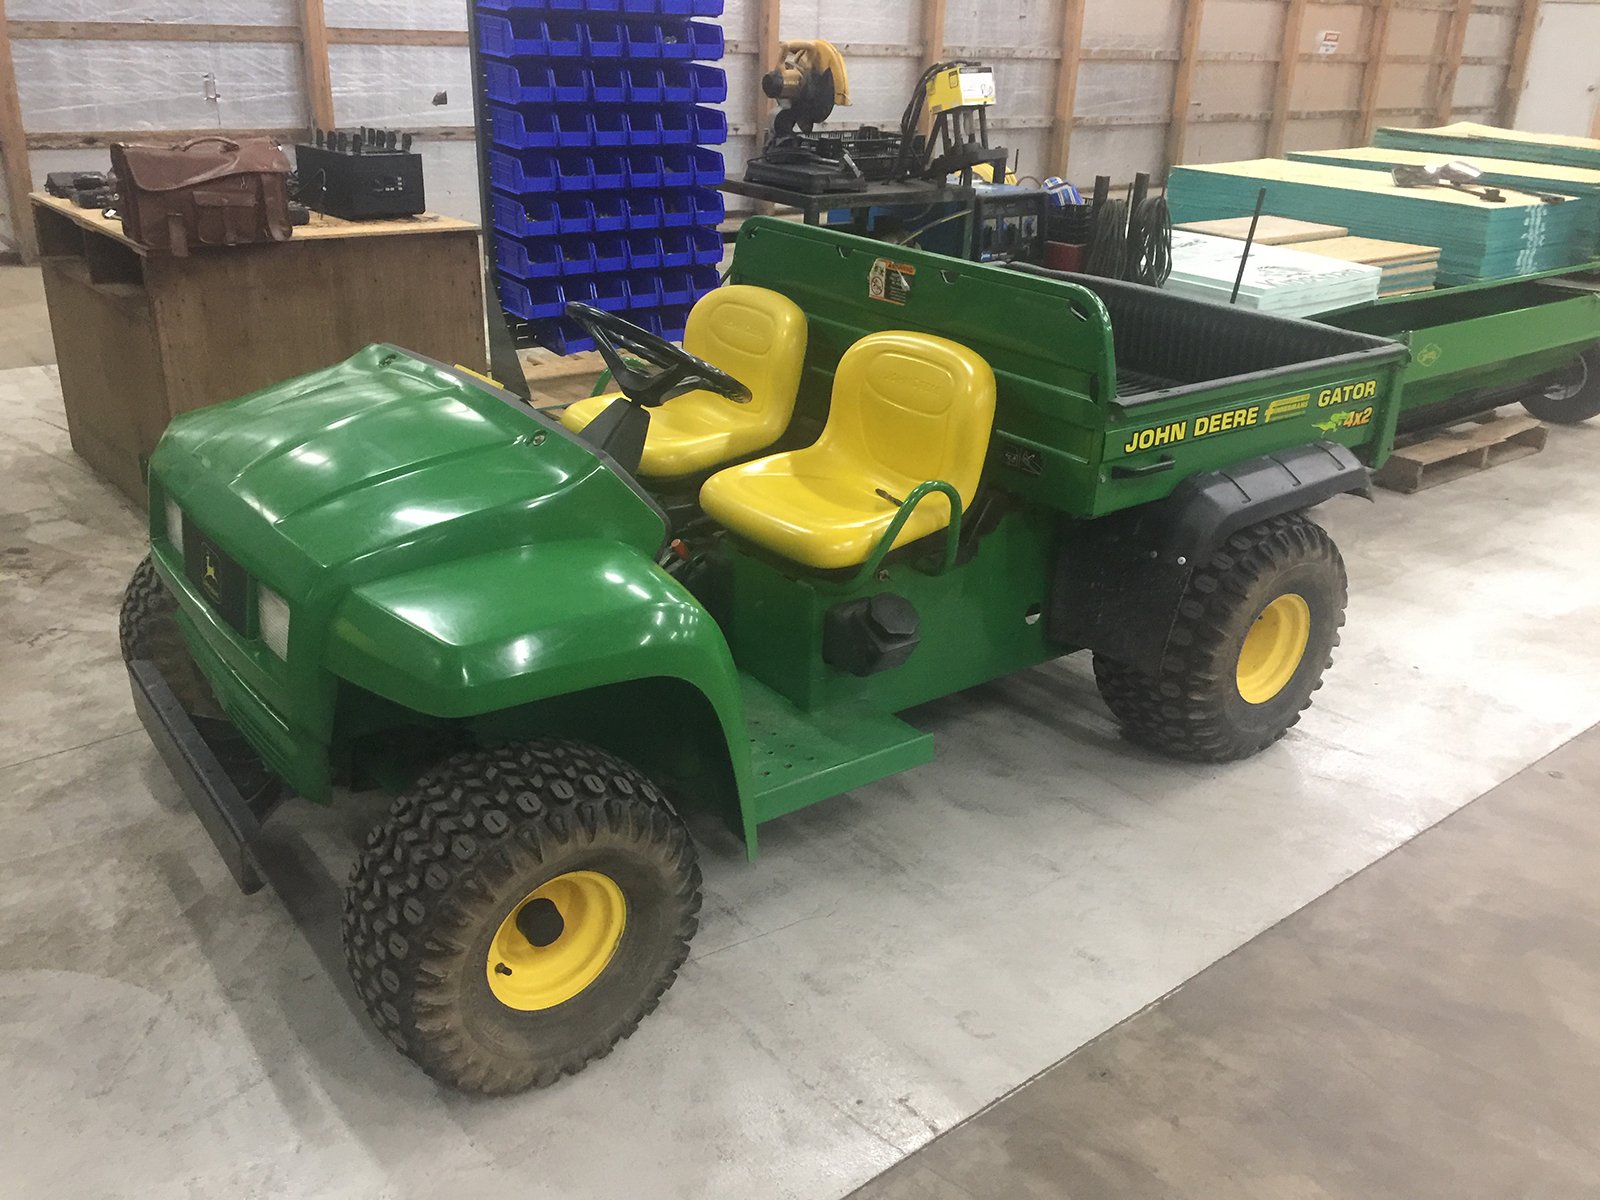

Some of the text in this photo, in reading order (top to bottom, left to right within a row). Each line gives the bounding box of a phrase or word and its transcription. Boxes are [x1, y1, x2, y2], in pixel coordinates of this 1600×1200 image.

[1317, 379, 1377, 408] GATOR
[1124, 420, 1187, 453] JOHN
[1193, 405, 1260, 437] DEERE
